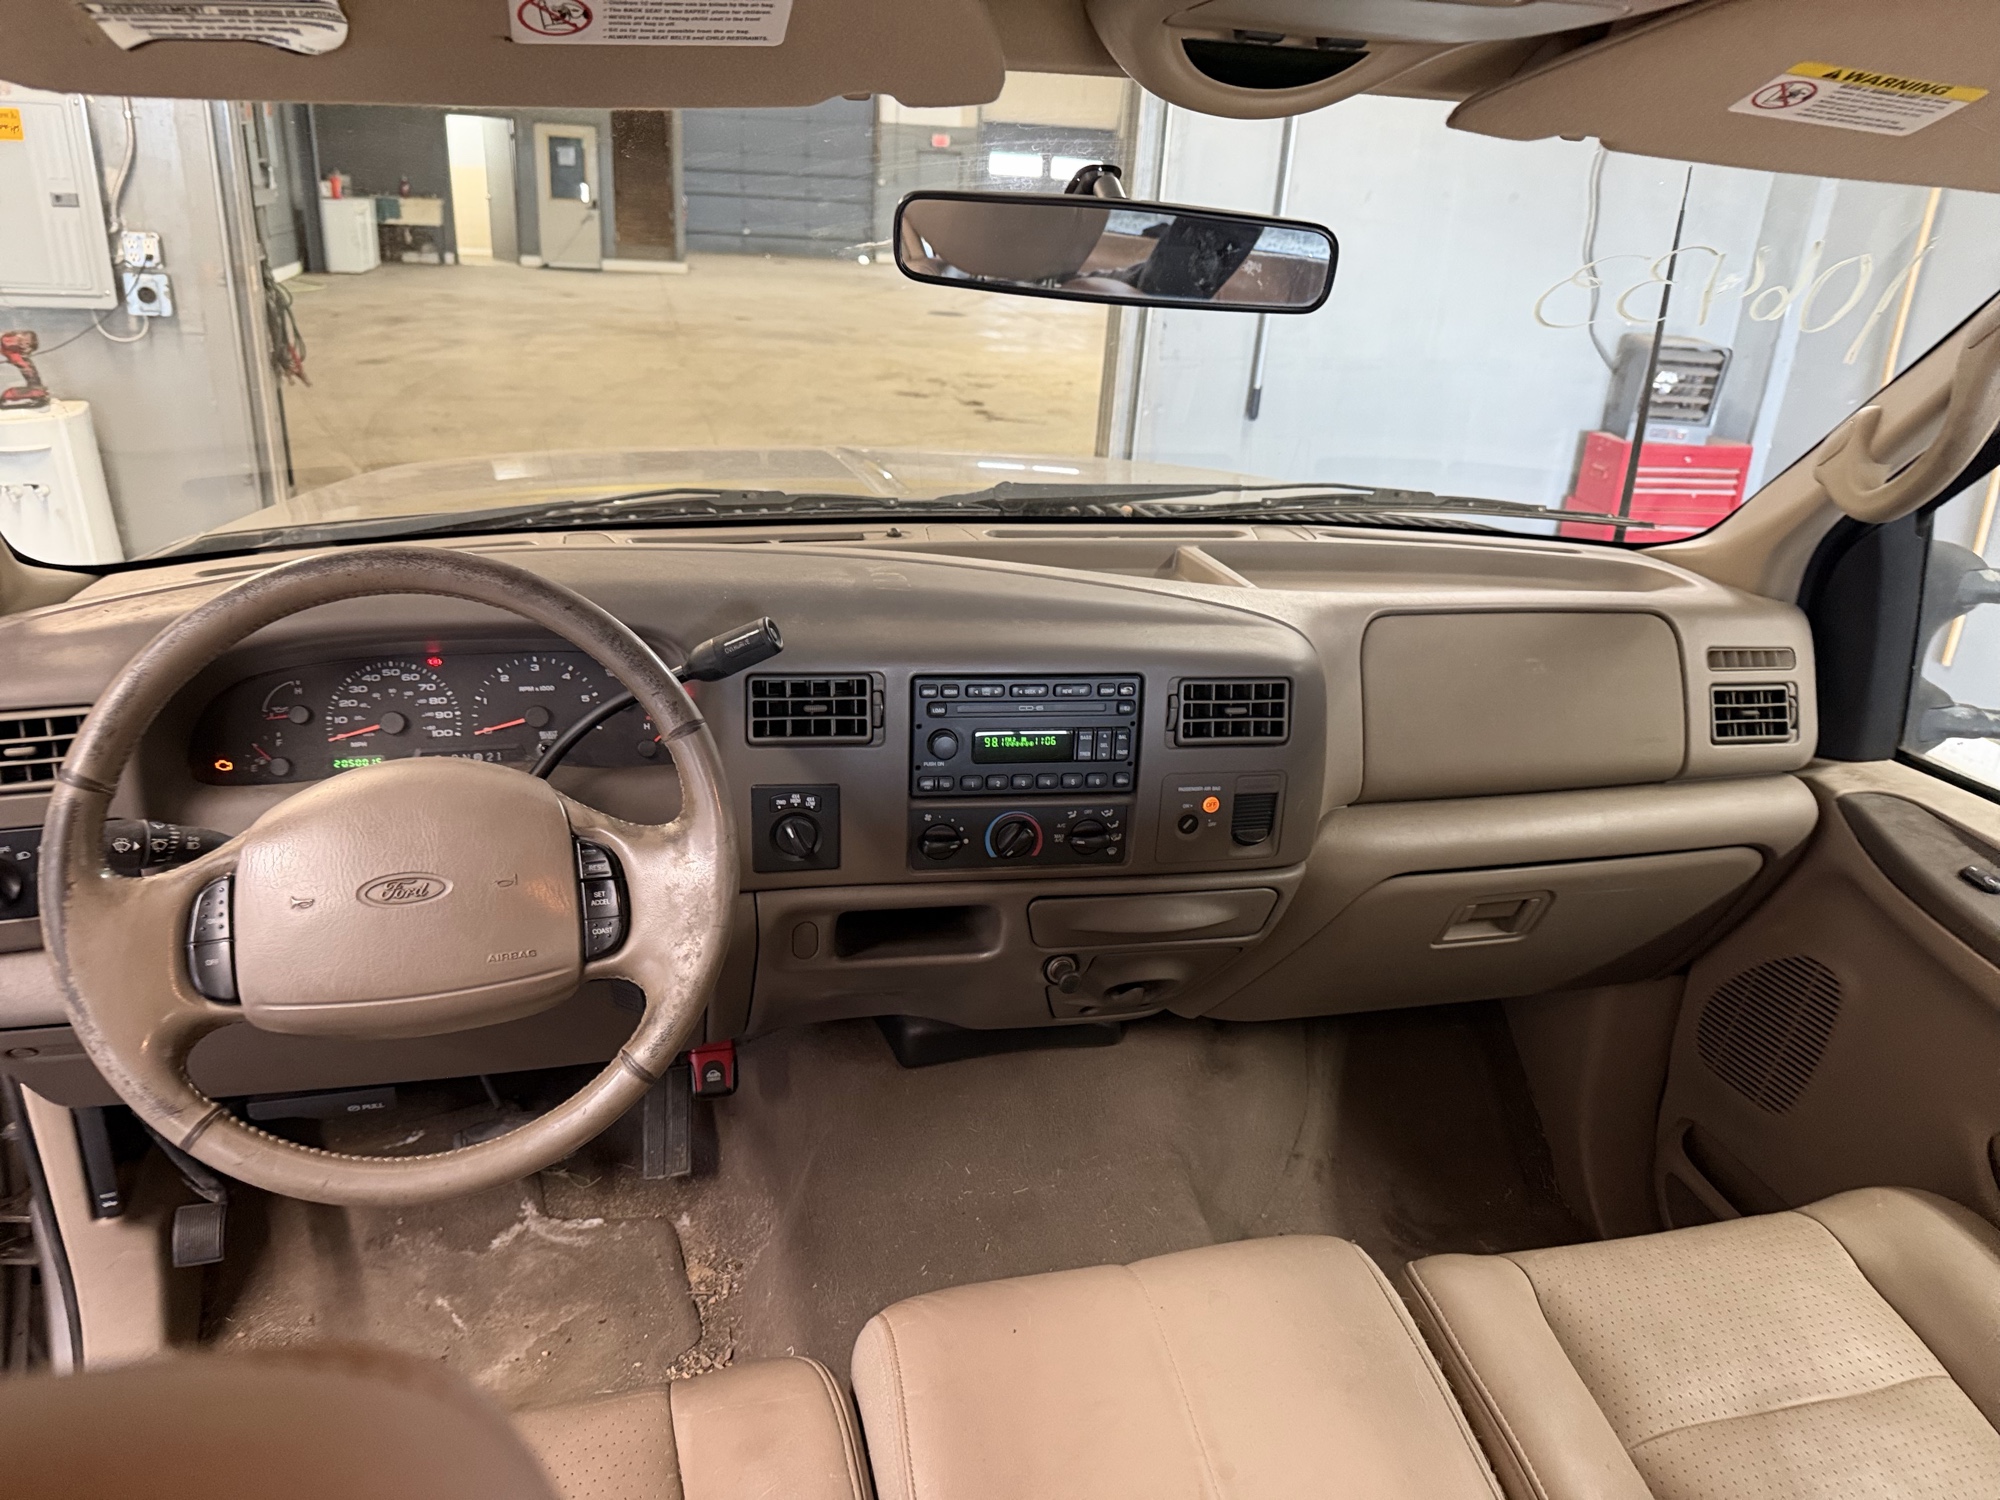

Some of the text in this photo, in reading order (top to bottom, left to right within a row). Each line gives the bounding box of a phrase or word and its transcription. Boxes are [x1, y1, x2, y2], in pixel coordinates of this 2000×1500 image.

[1842, 70, 1954, 96] WARNING
[529, 663, 540, 672] 3
[382, 668, 401, 677] 50
[561, 672, 571, 680] 4
[362, 674, 381, 682] 40
[401, 673, 421, 681] 60
[499, 674, 510, 683] 2
[348, 685, 368, 693] 30
[418, 683, 436, 691] 70
[428, 697, 448, 705] 80
[482, 697, 488, 705] 1
[580, 694, 591, 703] 5
[434, 711, 453, 719] 90
[334, 716, 348, 724] 10
[643, 722, 651, 730] H
[431, 729, 453, 737] 100
[486, 752, 494, 762] 2
[496, 751, 502, 761] 1
[381, 879, 430, 901] Ford
[593, 890, 606, 898] SET
[590, 898, 611, 907] ACCEL
[591, 926, 614, 935] COAST
[486, 949, 538, 963] AIRBAG
